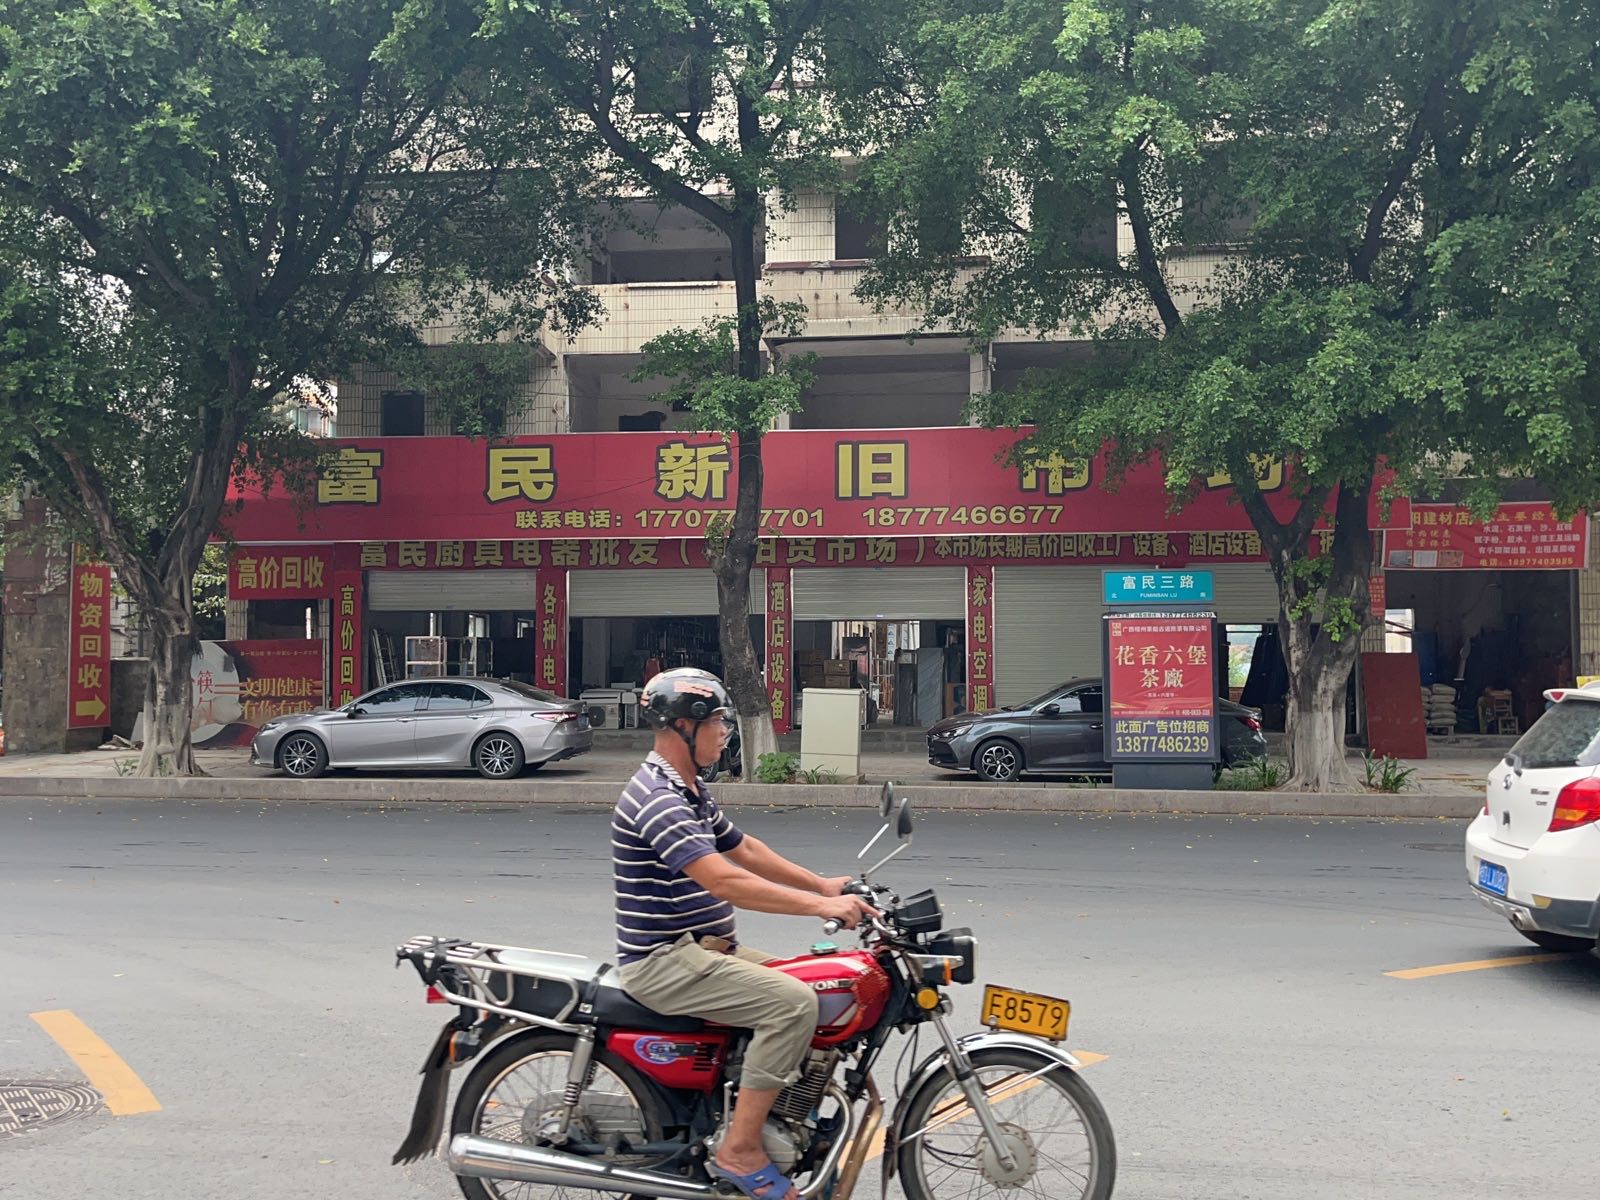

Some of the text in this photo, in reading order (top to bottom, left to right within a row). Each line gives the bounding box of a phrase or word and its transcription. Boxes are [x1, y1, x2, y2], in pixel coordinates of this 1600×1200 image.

[634, 508, 824, 528] 1770777701
[862, 505, 1065, 526] 18777466677
[237, 556, 325, 589] 高价回收
[1122, 574, 1195, 590] 富民三路
[542, 583, 557, 698] 各种电
[770, 581, 785, 720] 酒店设备
[972, 575, 988, 713] 家电空调
[1114, 644, 1208, 667] 花香六堡
[242, 677, 314, 698] 文明健康
[1115, 720, 1210, 734] 此面广告位招商
[1116, 735, 1209, 753] 13877486239
[988, 993, 1064, 1030] E8579
